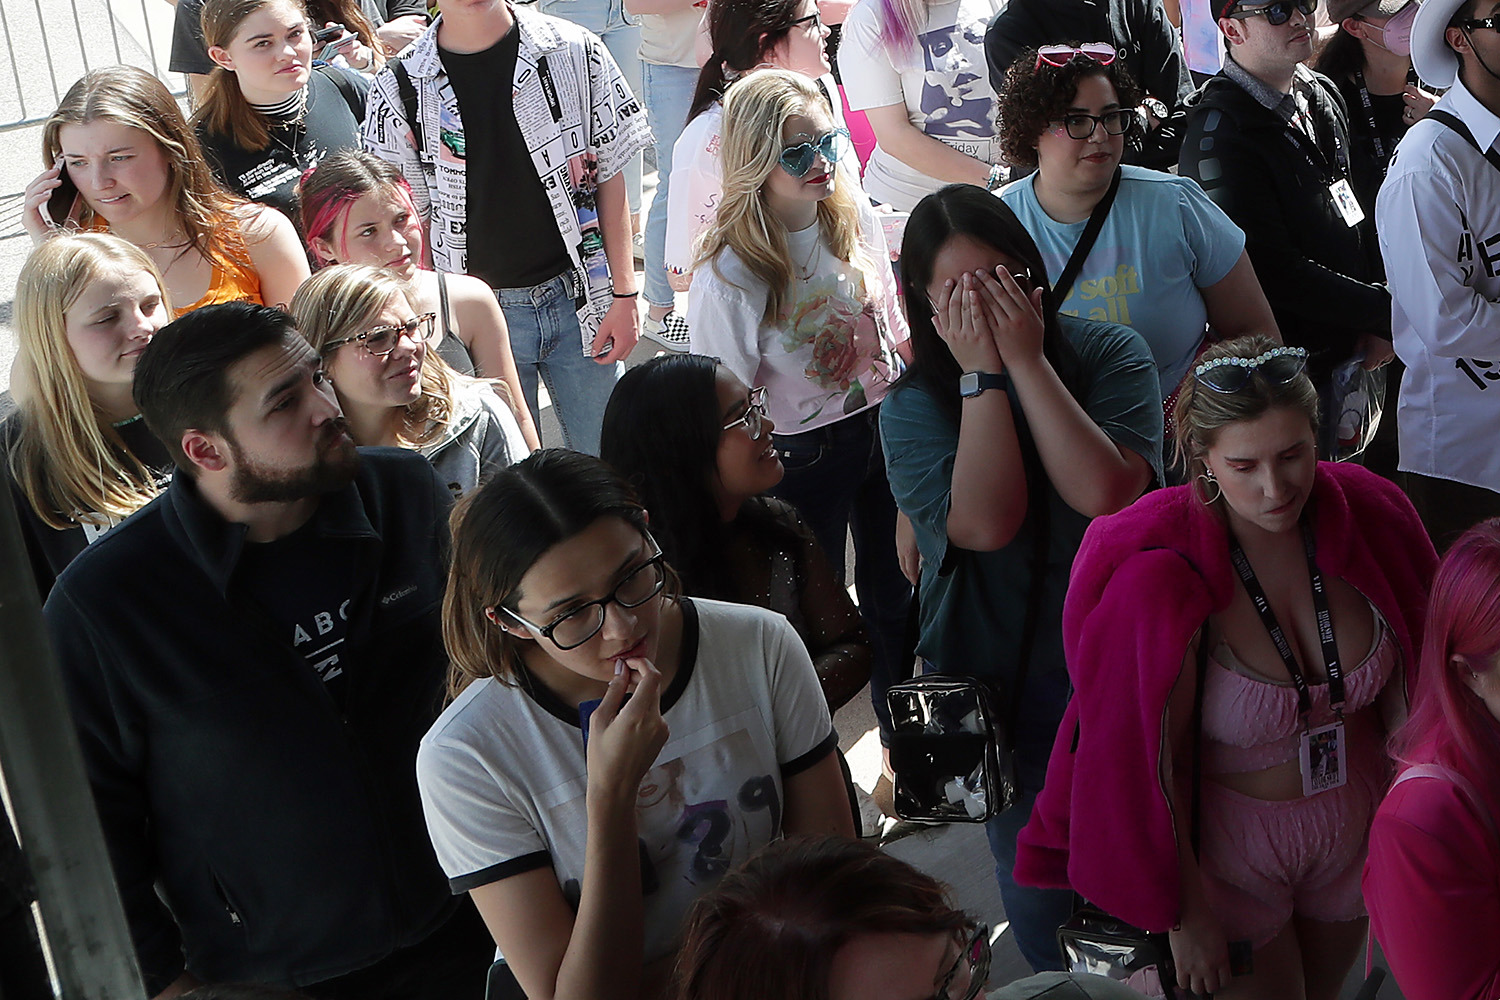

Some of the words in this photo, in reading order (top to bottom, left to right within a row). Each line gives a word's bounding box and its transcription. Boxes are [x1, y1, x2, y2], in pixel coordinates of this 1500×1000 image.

[1080, 264, 1139, 300] soft
[1313, 574, 1322, 593] VIP
[1254, 595, 1268, 613] VIP
[1328, 661, 1339, 679] VIP
